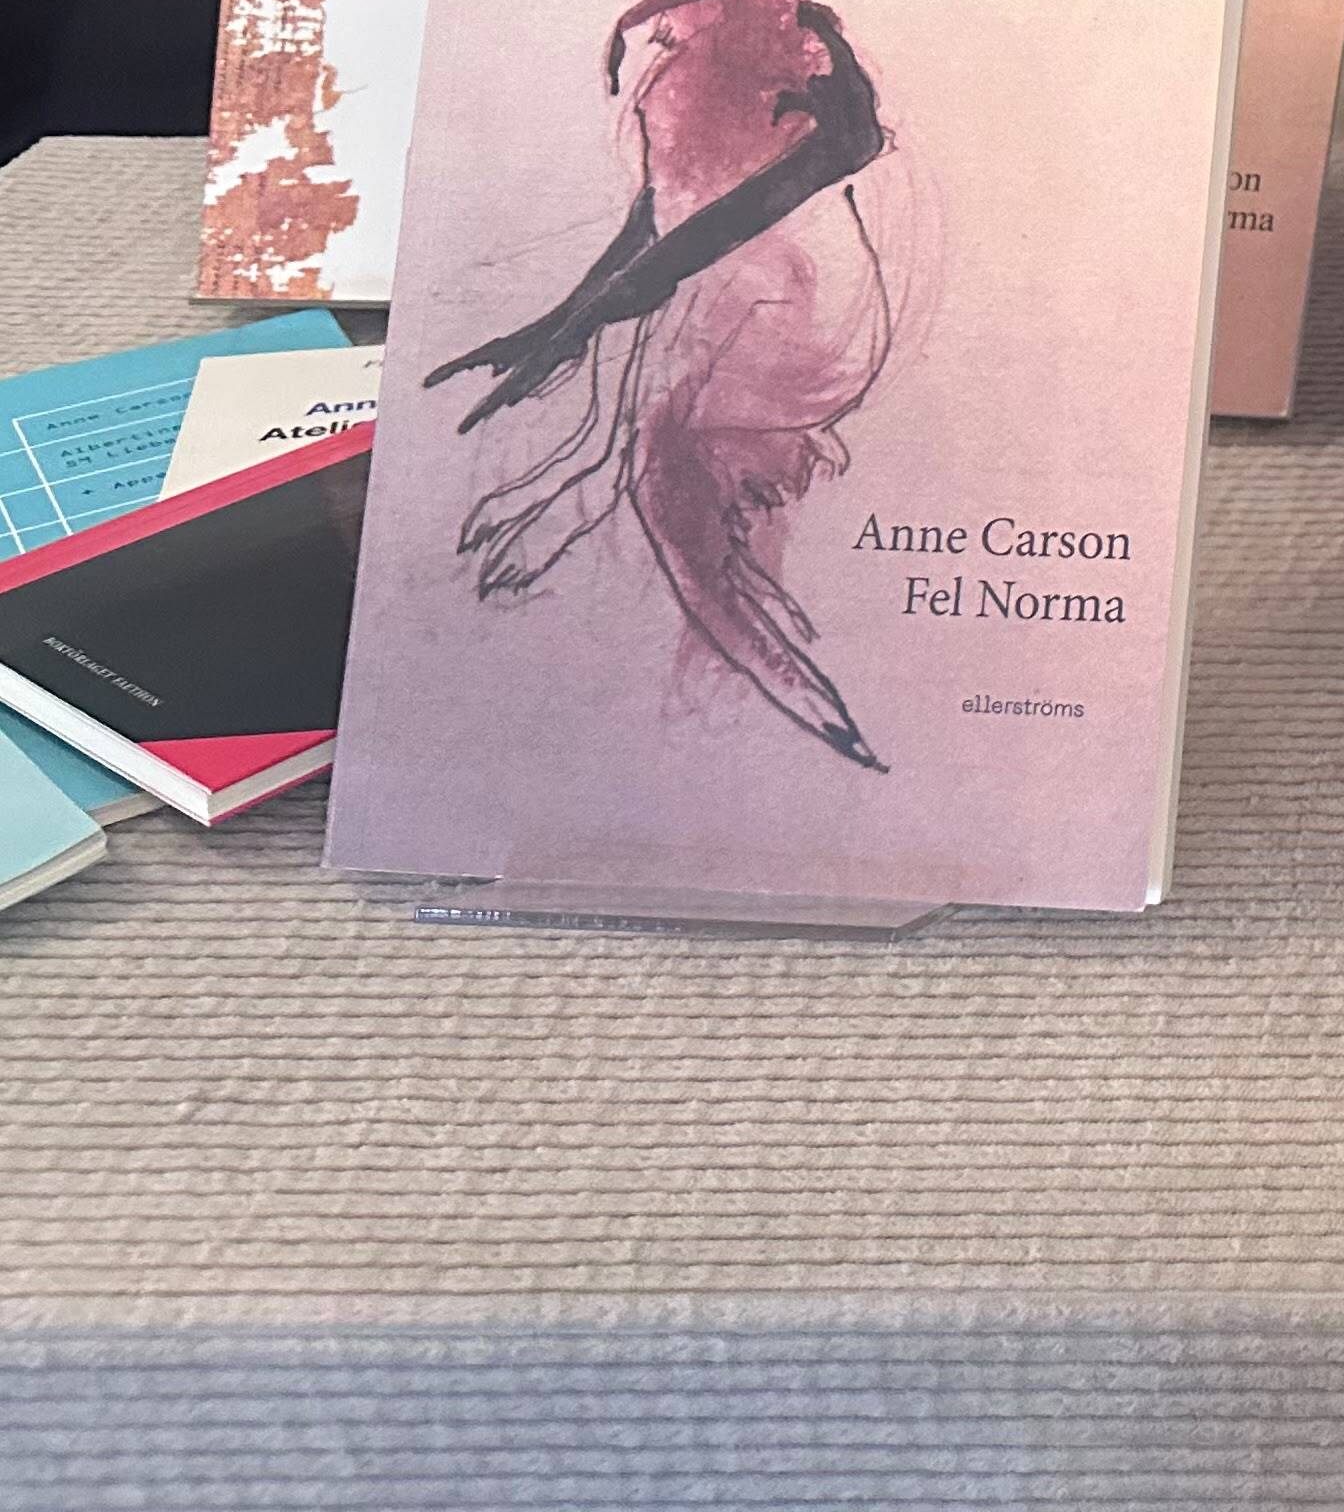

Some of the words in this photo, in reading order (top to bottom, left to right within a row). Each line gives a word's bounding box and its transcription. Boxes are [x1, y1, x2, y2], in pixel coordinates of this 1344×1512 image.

[852, 513, 968, 554] Anne
[981, 517, 1132, 561] Carson
[902, 576, 963, 617] Fel
[975, 580, 1127, 624] Norma
[961, 694, 1085, 718] ellerströms
